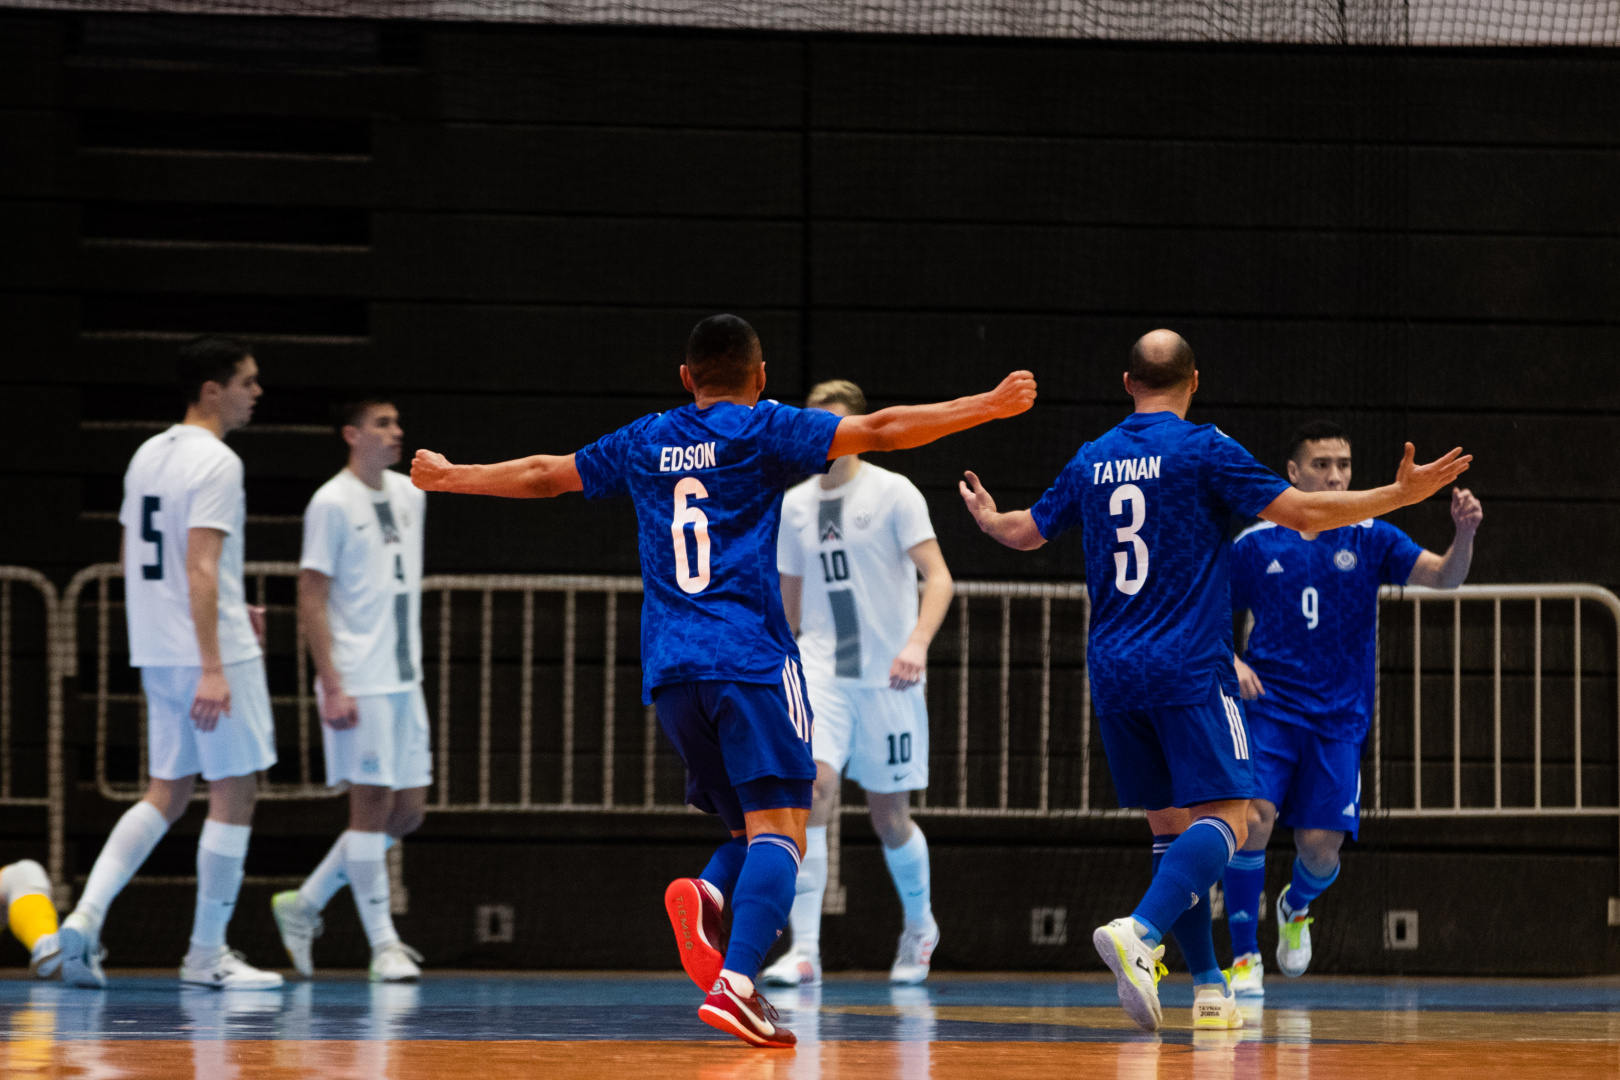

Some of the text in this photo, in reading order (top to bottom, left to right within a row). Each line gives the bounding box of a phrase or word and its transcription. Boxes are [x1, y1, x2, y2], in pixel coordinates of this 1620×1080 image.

[659, 441, 716, 472] EDSON
[1093, 456, 1162, 485] TAYNAN
[142, 495, 164, 580] 5
[671, 476, 711, 594] 6
[1109, 483, 1149, 596] 3
[820, 549, 850, 583] 10
[1302, 586, 1319, 630] 9
[887, 732, 912, 766] 10
[676, 895, 694, 951] TIEMPO
